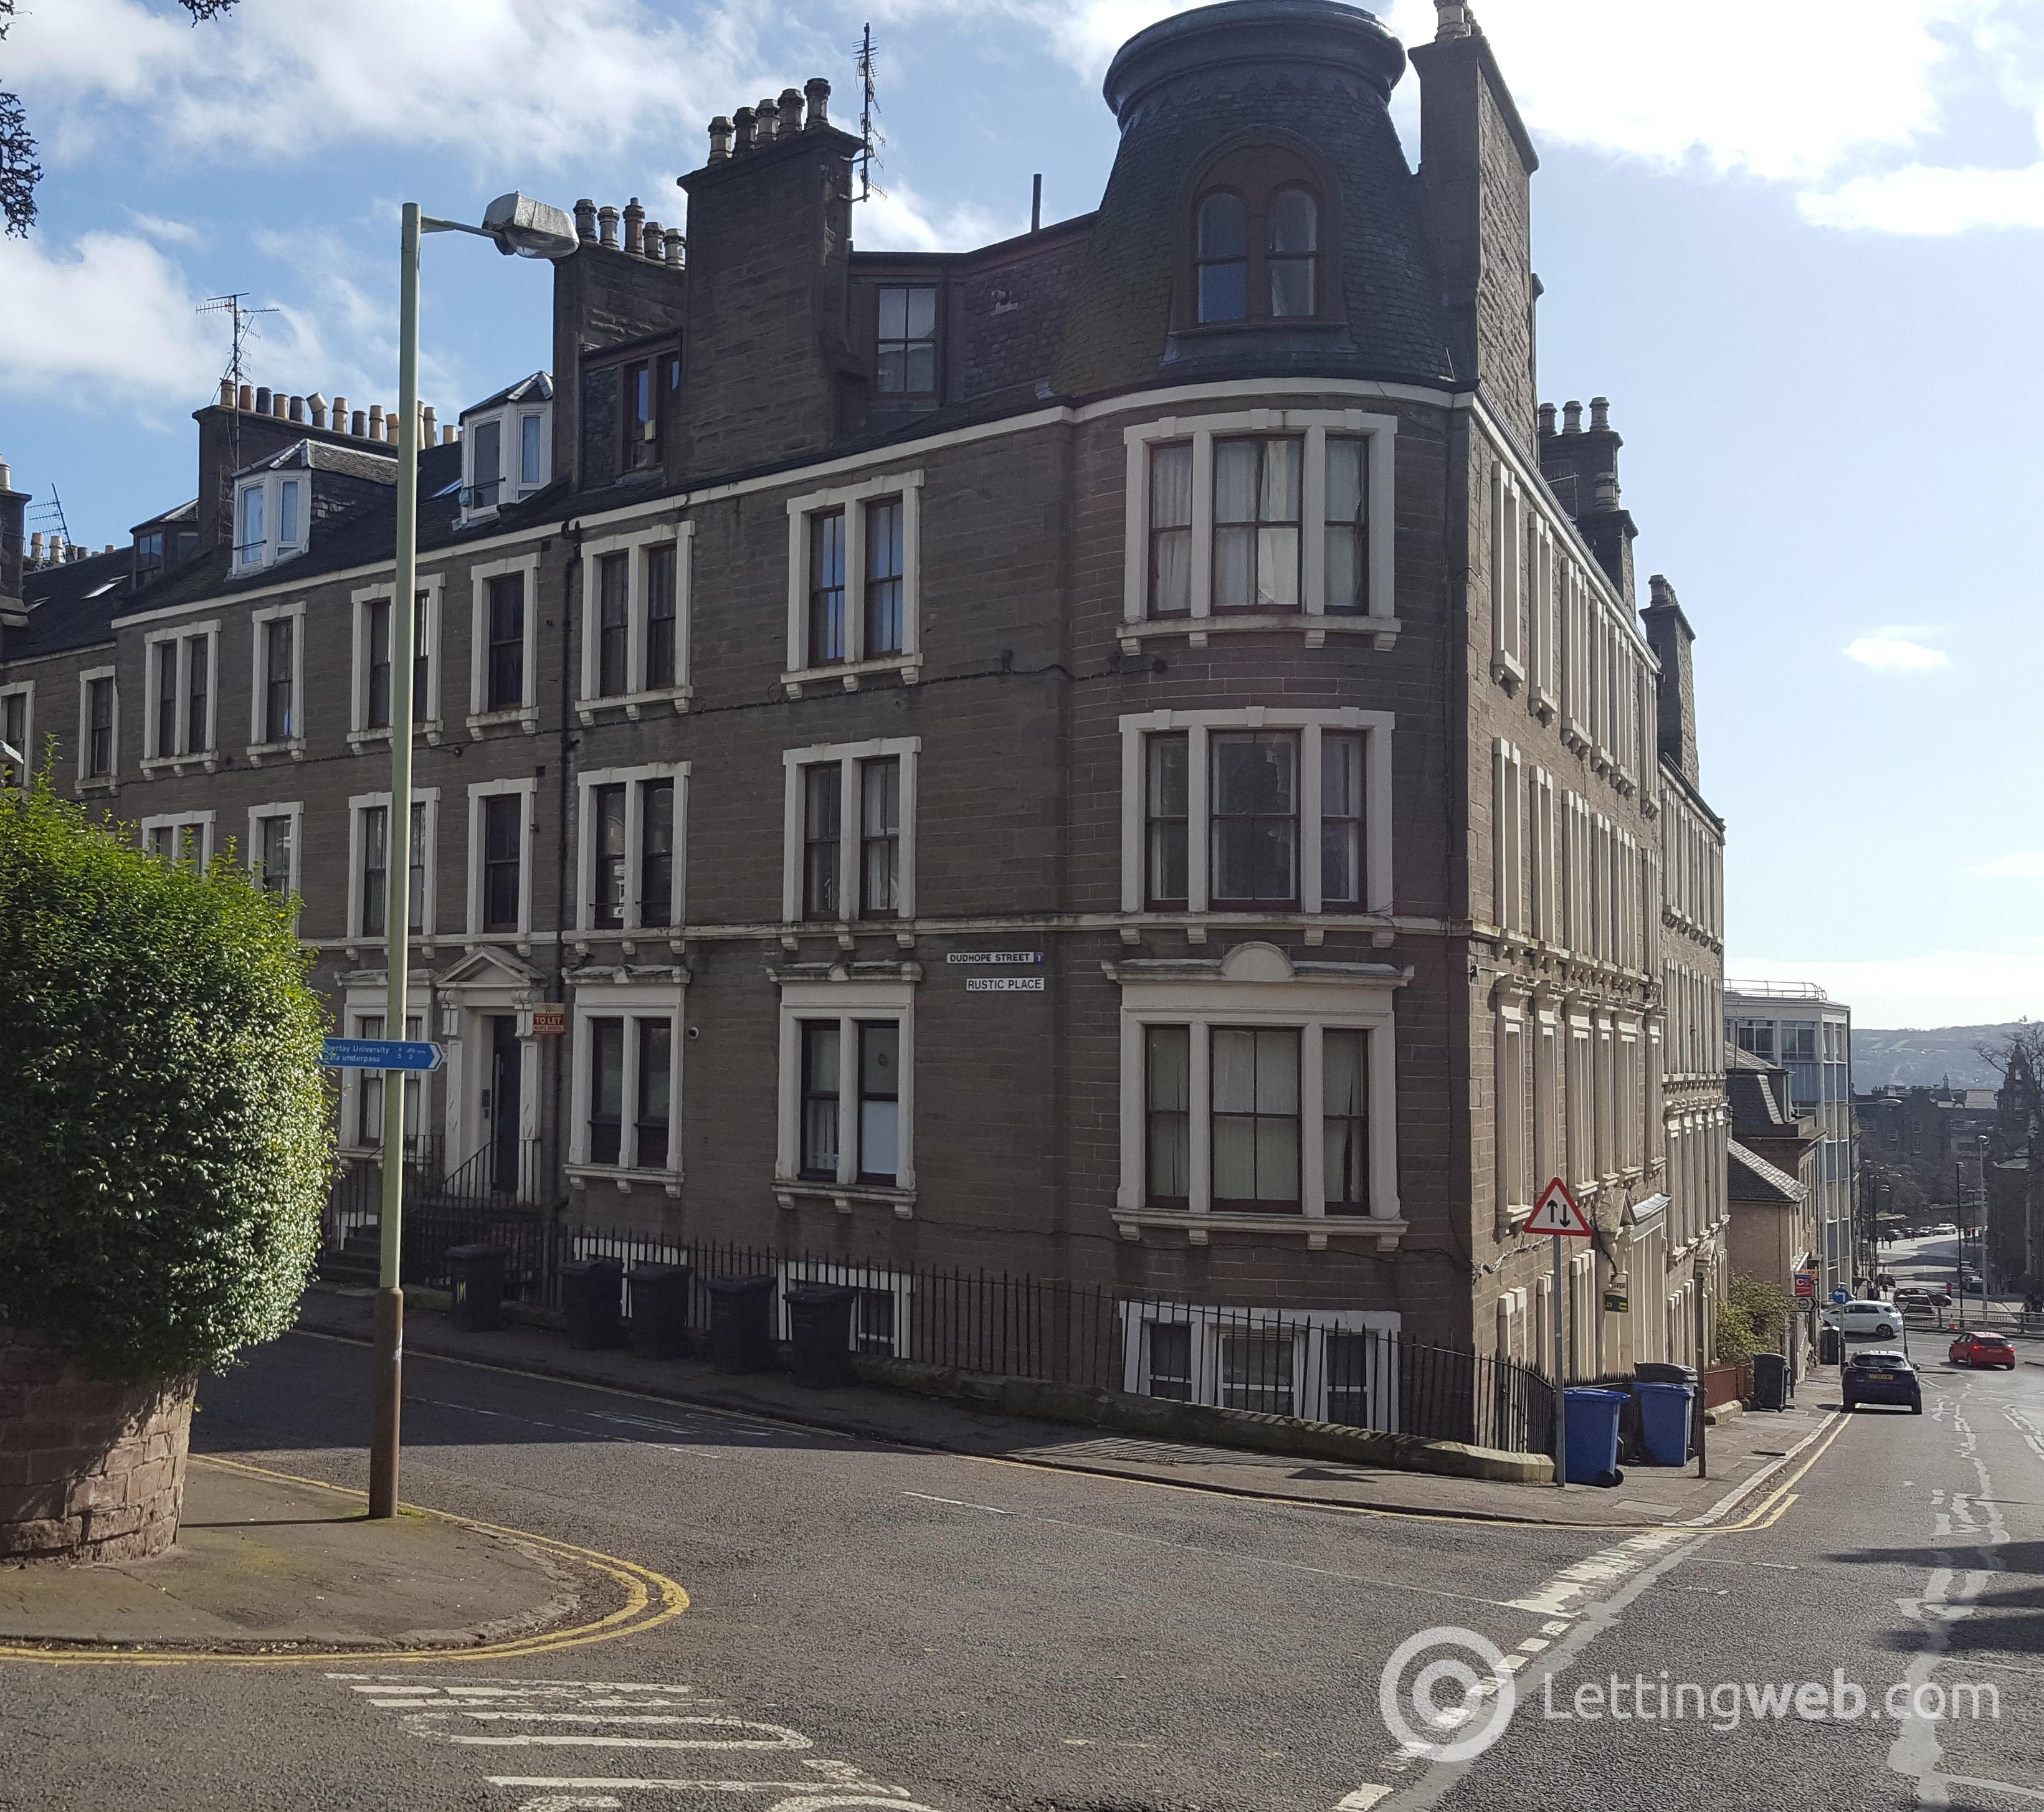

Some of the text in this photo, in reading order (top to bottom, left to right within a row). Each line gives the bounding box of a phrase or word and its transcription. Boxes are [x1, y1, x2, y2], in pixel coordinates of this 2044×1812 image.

[949, 953, 1030, 962] DUDHOPE STREET
[967, 979, 1042, 990] RUSTIC PLACE
[535, 1017, 562, 1025] TO LET
[352, 1045, 391, 1055] University
[342, 1055, 381, 1063] underpass
